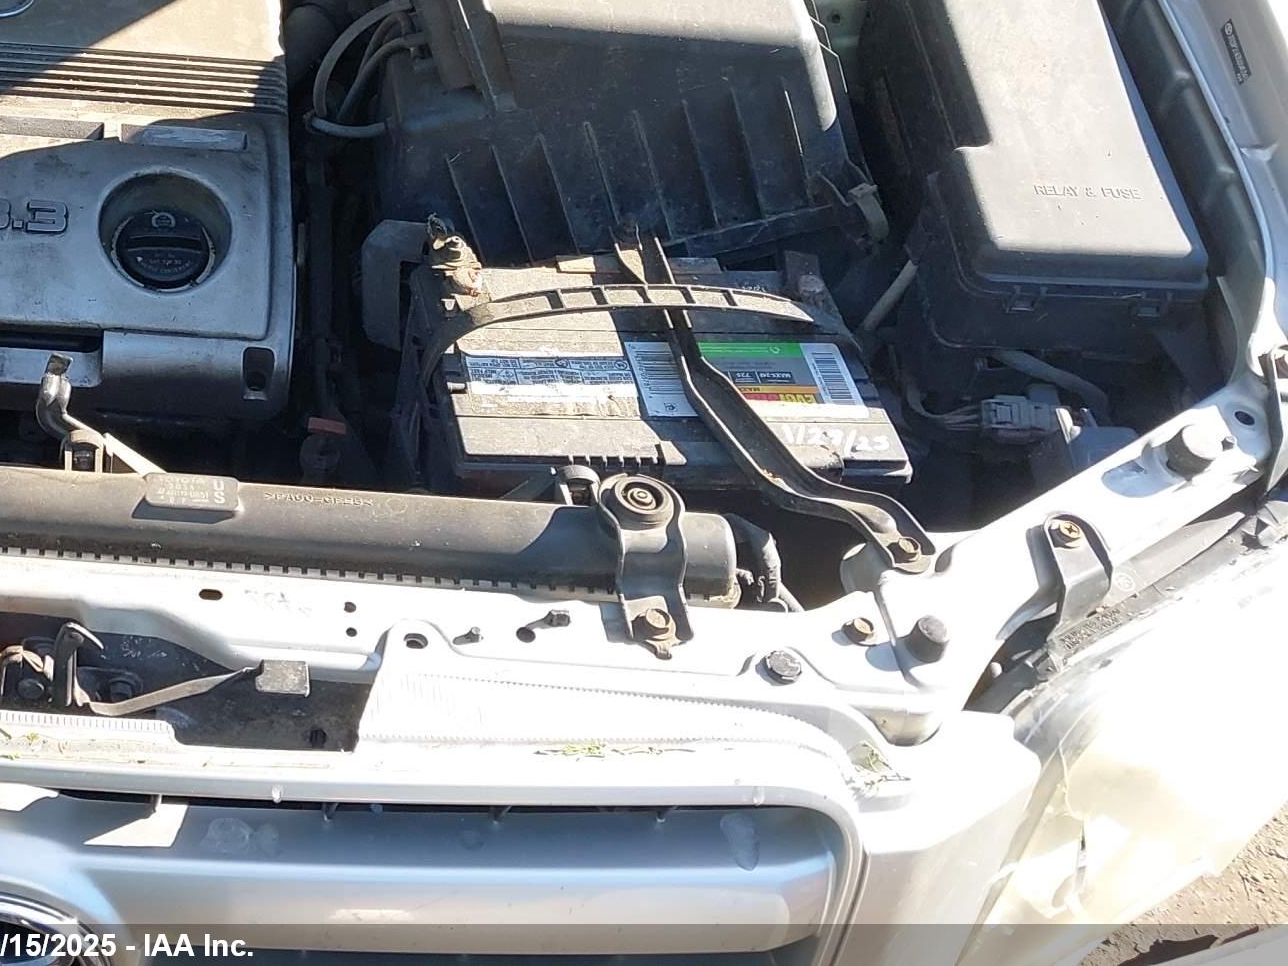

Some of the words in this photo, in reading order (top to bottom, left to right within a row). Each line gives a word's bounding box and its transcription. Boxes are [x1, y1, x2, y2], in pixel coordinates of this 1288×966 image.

[1033, 185, 1079, 197] RELAY
[1085, 186, 1097, 198] &
[1100, 186, 1142, 200] FUSE
